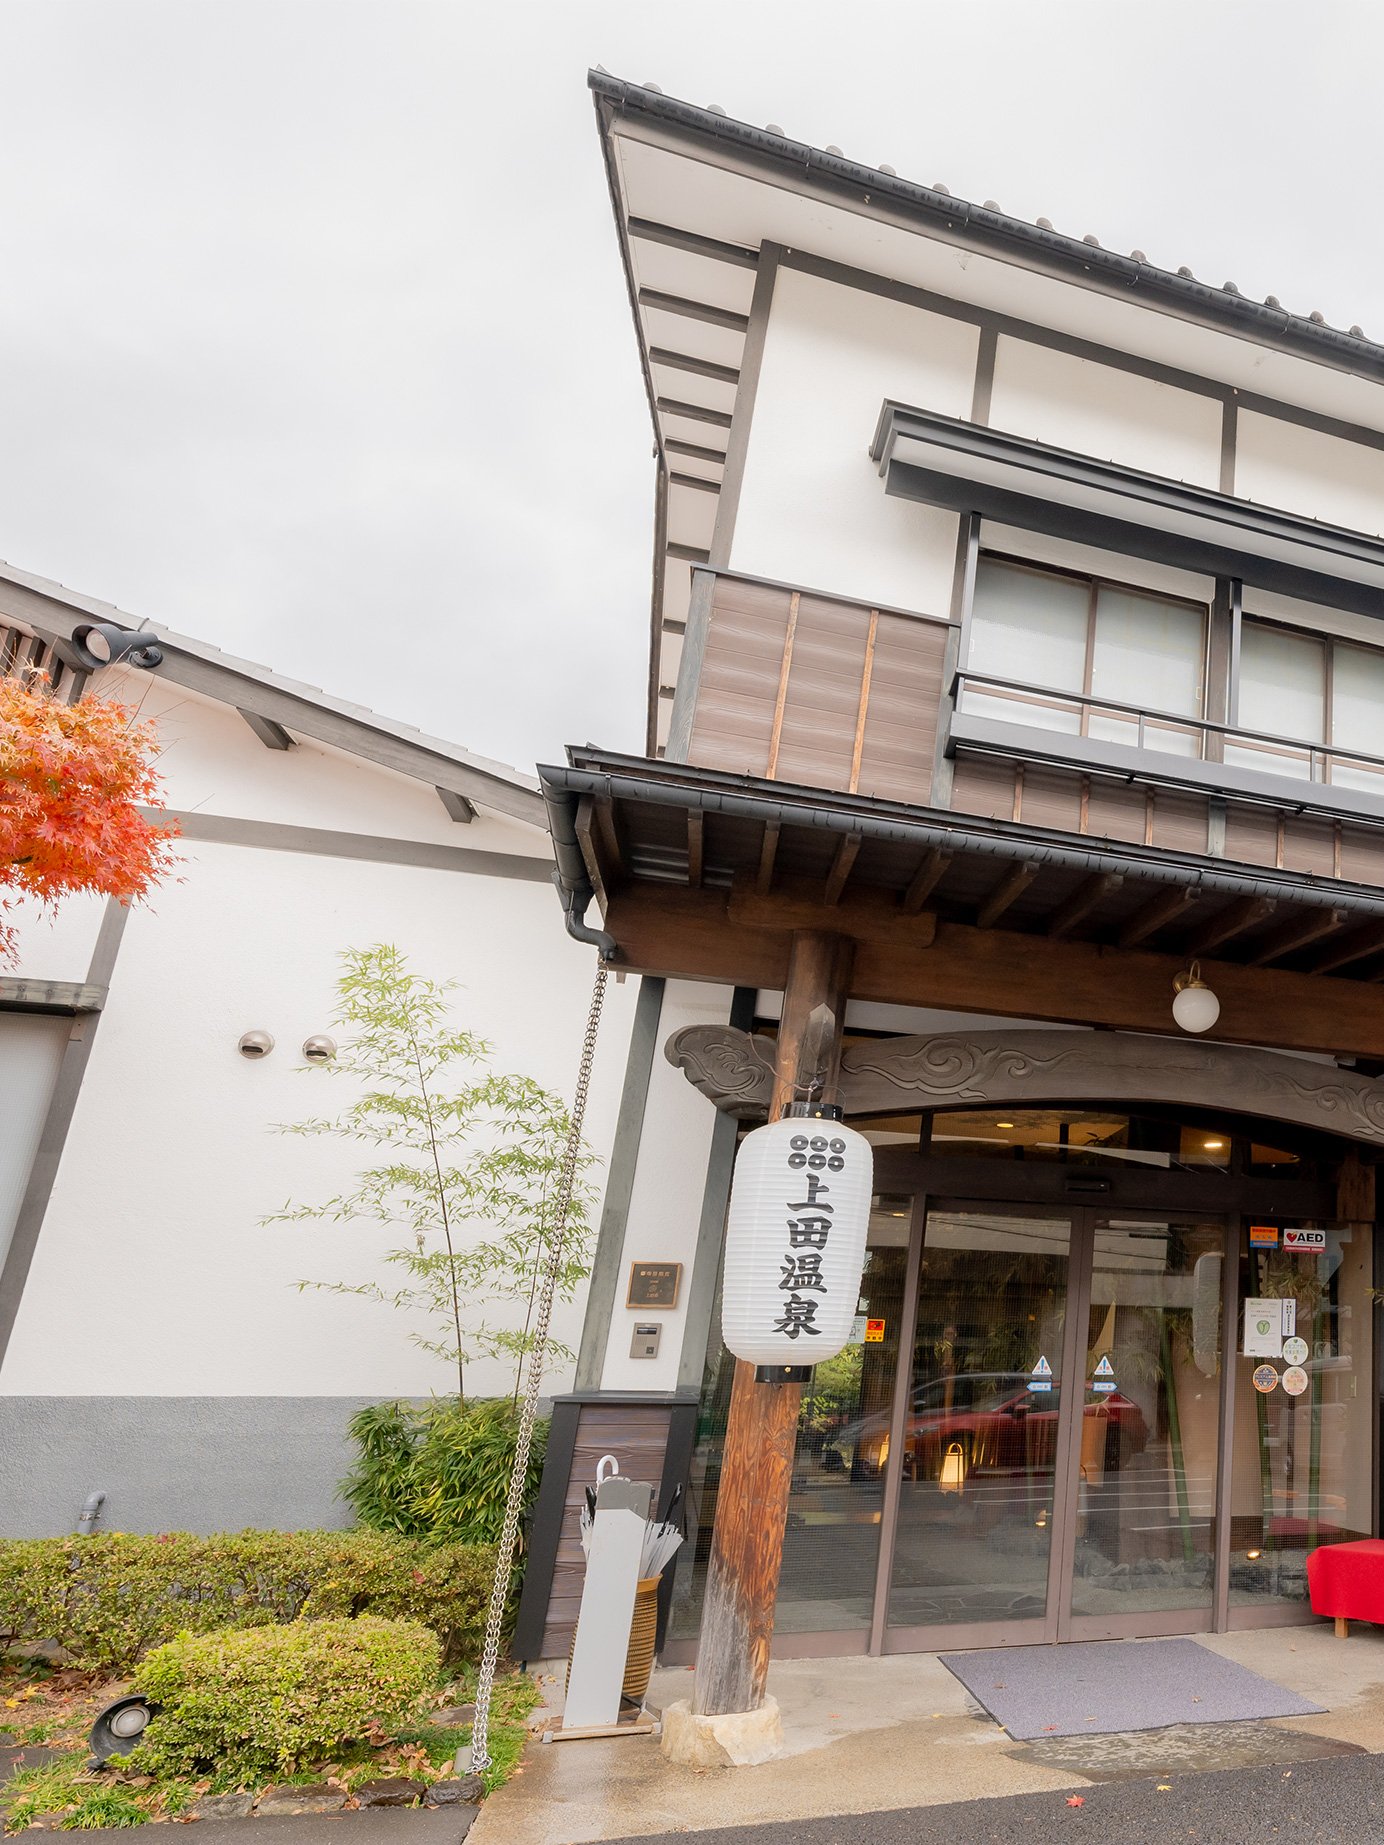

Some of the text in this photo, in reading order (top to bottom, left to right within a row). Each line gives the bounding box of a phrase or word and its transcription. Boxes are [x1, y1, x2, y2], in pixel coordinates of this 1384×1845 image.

[771, 1172, 835, 1340] 上田温泉
[1297, 1232, 1324, 1243] AED
